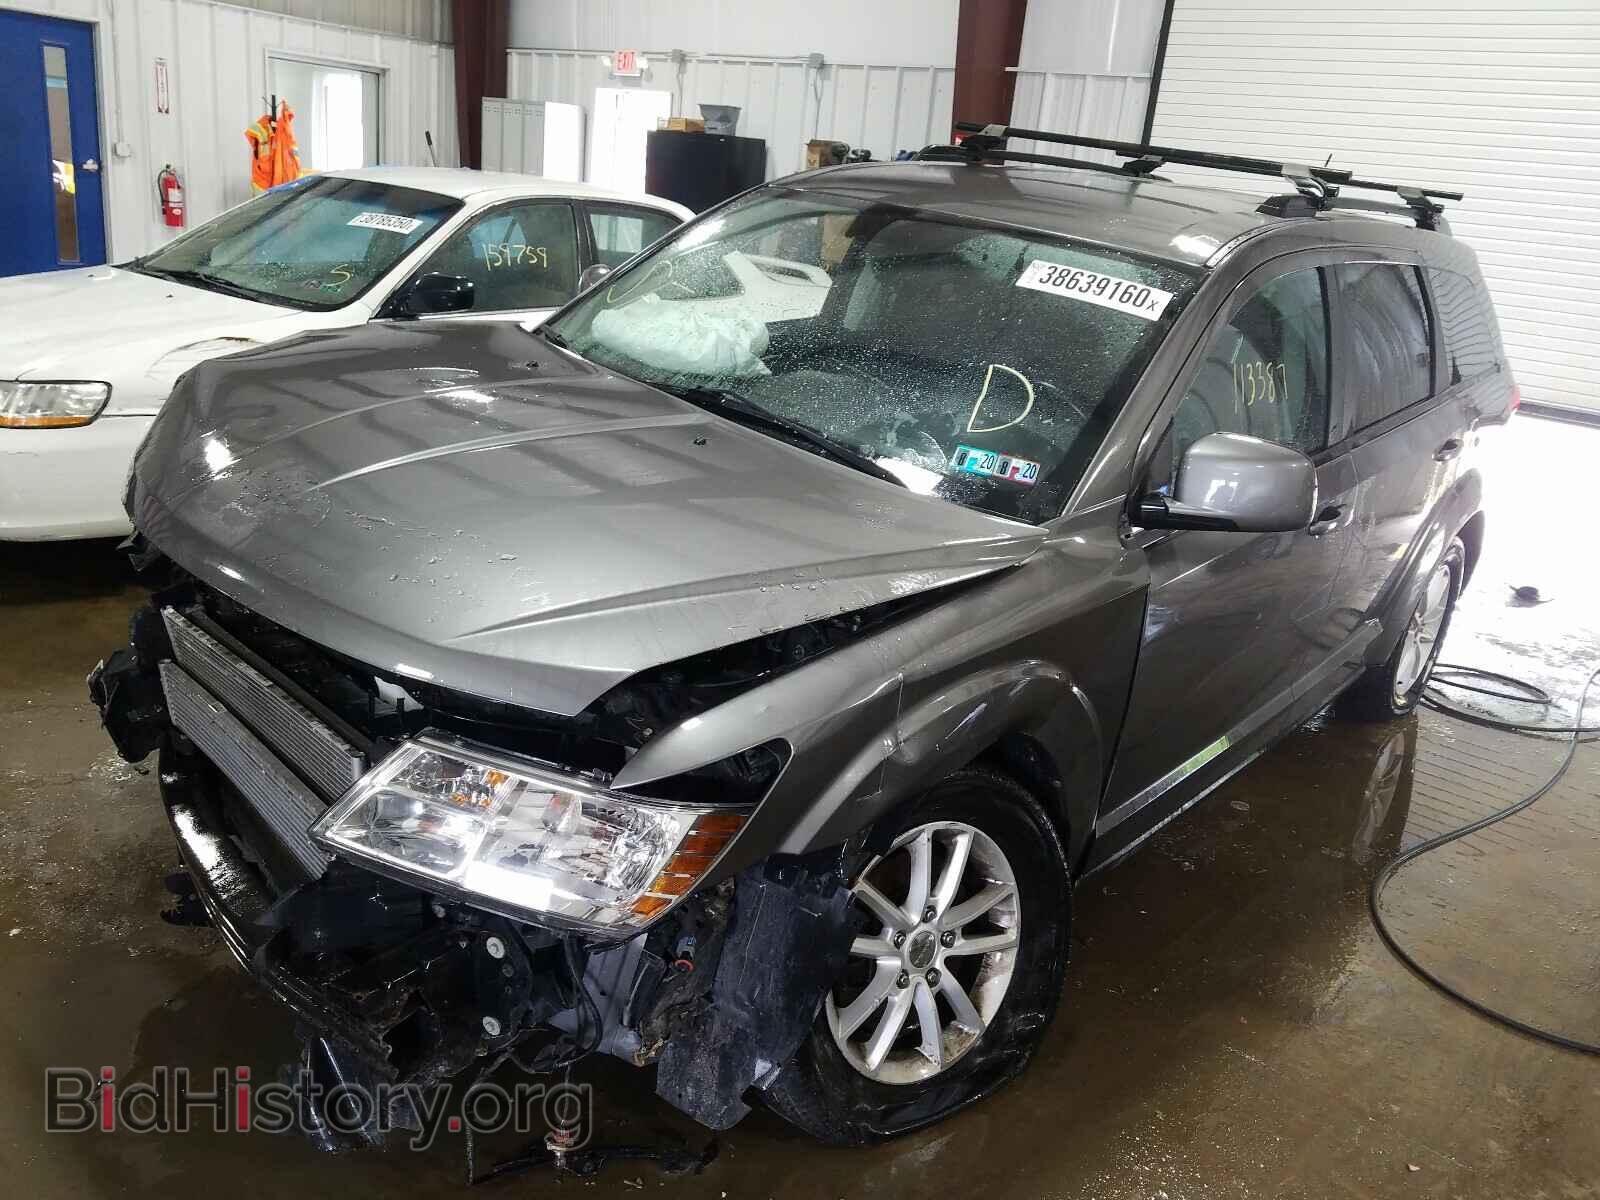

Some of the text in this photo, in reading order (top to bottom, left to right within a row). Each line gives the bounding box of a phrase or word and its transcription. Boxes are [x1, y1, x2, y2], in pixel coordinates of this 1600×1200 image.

[482, 243, 548, 271] 159759
[1039, 265, 1152, 308] 38639160
[966, 363, 1035, 433] D
[980, 454, 995, 470] 20
[999, 461, 1037, 480] 8 20
